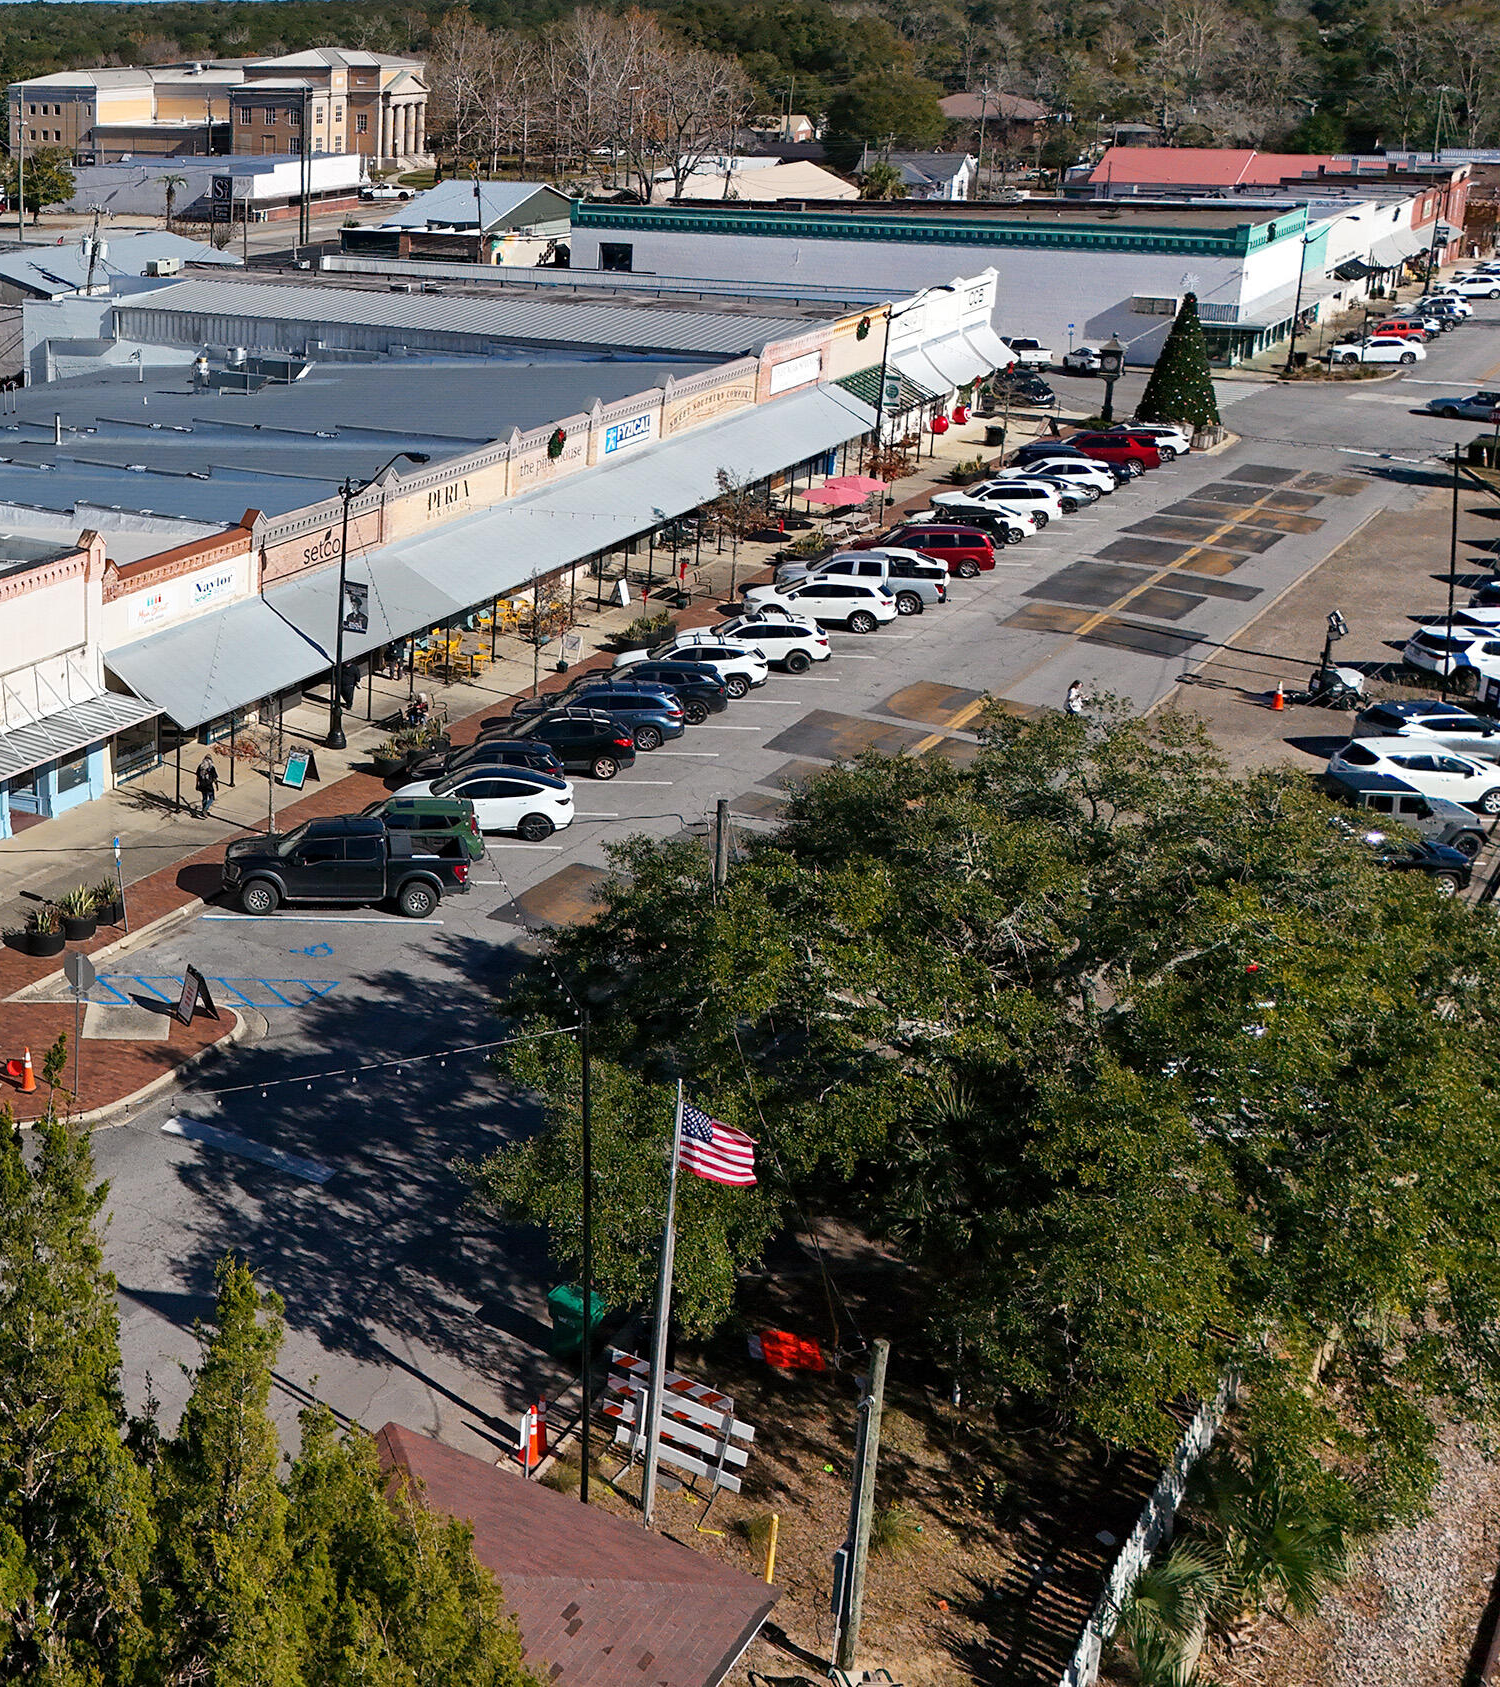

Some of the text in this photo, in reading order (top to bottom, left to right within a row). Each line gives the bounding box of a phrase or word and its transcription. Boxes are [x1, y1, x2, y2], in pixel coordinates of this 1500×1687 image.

[617, 416, 650, 441] FYZICAL
[520, 460, 535, 477] the
[428, 480, 469, 511] PERLA
[303, 538, 341, 565] setco
[195, 574, 233, 596] Naylor
